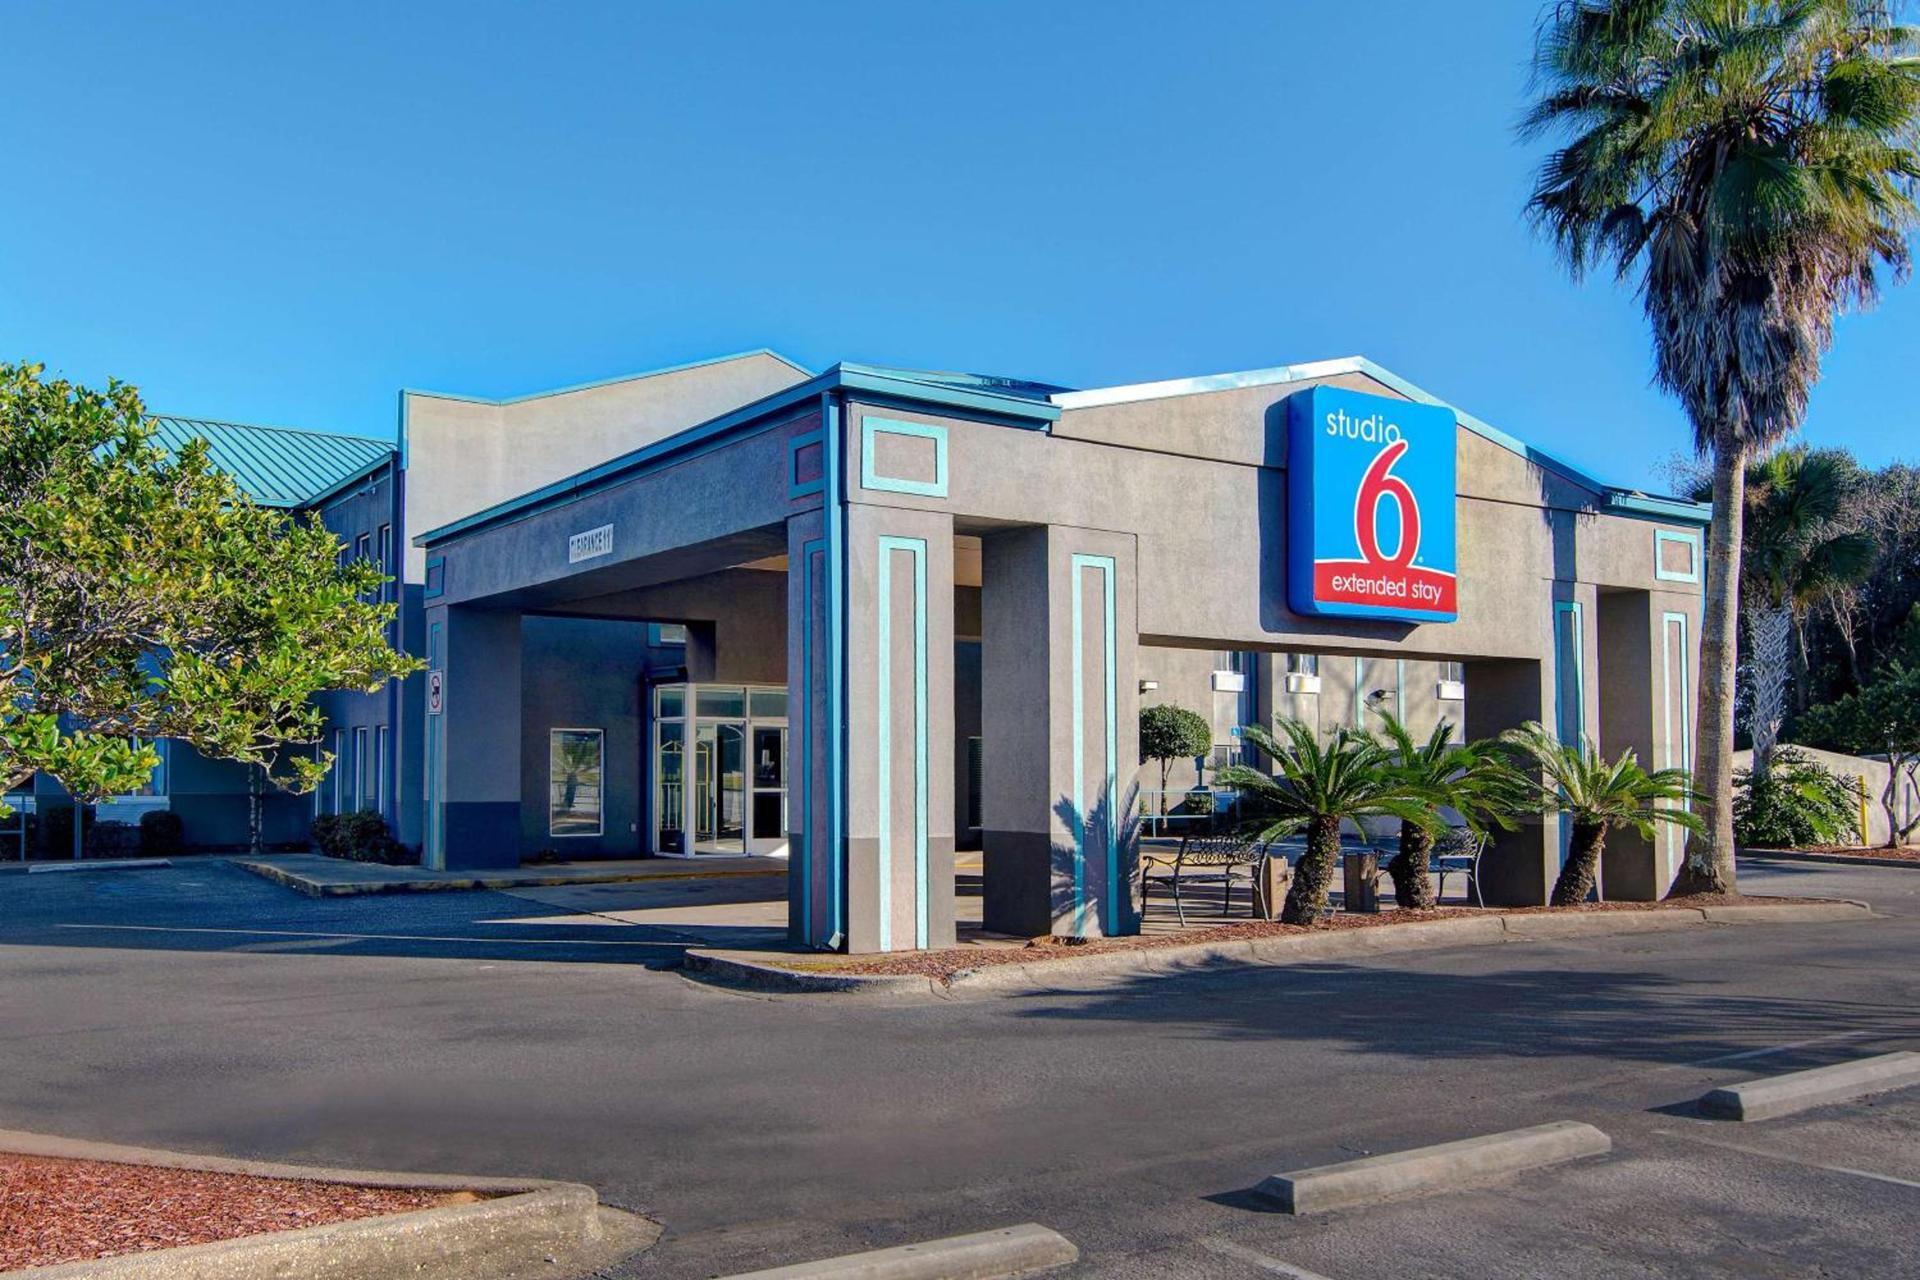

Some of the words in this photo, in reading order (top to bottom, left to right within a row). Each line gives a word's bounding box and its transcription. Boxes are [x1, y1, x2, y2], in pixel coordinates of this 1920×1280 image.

[1326, 408, 1401, 444] studio
[1354, 439, 1421, 567] 6
[571, 531, 602, 559] EARANCE
[1332, 573, 1406, 598] extended
[1411, 579, 1443, 605] stay
